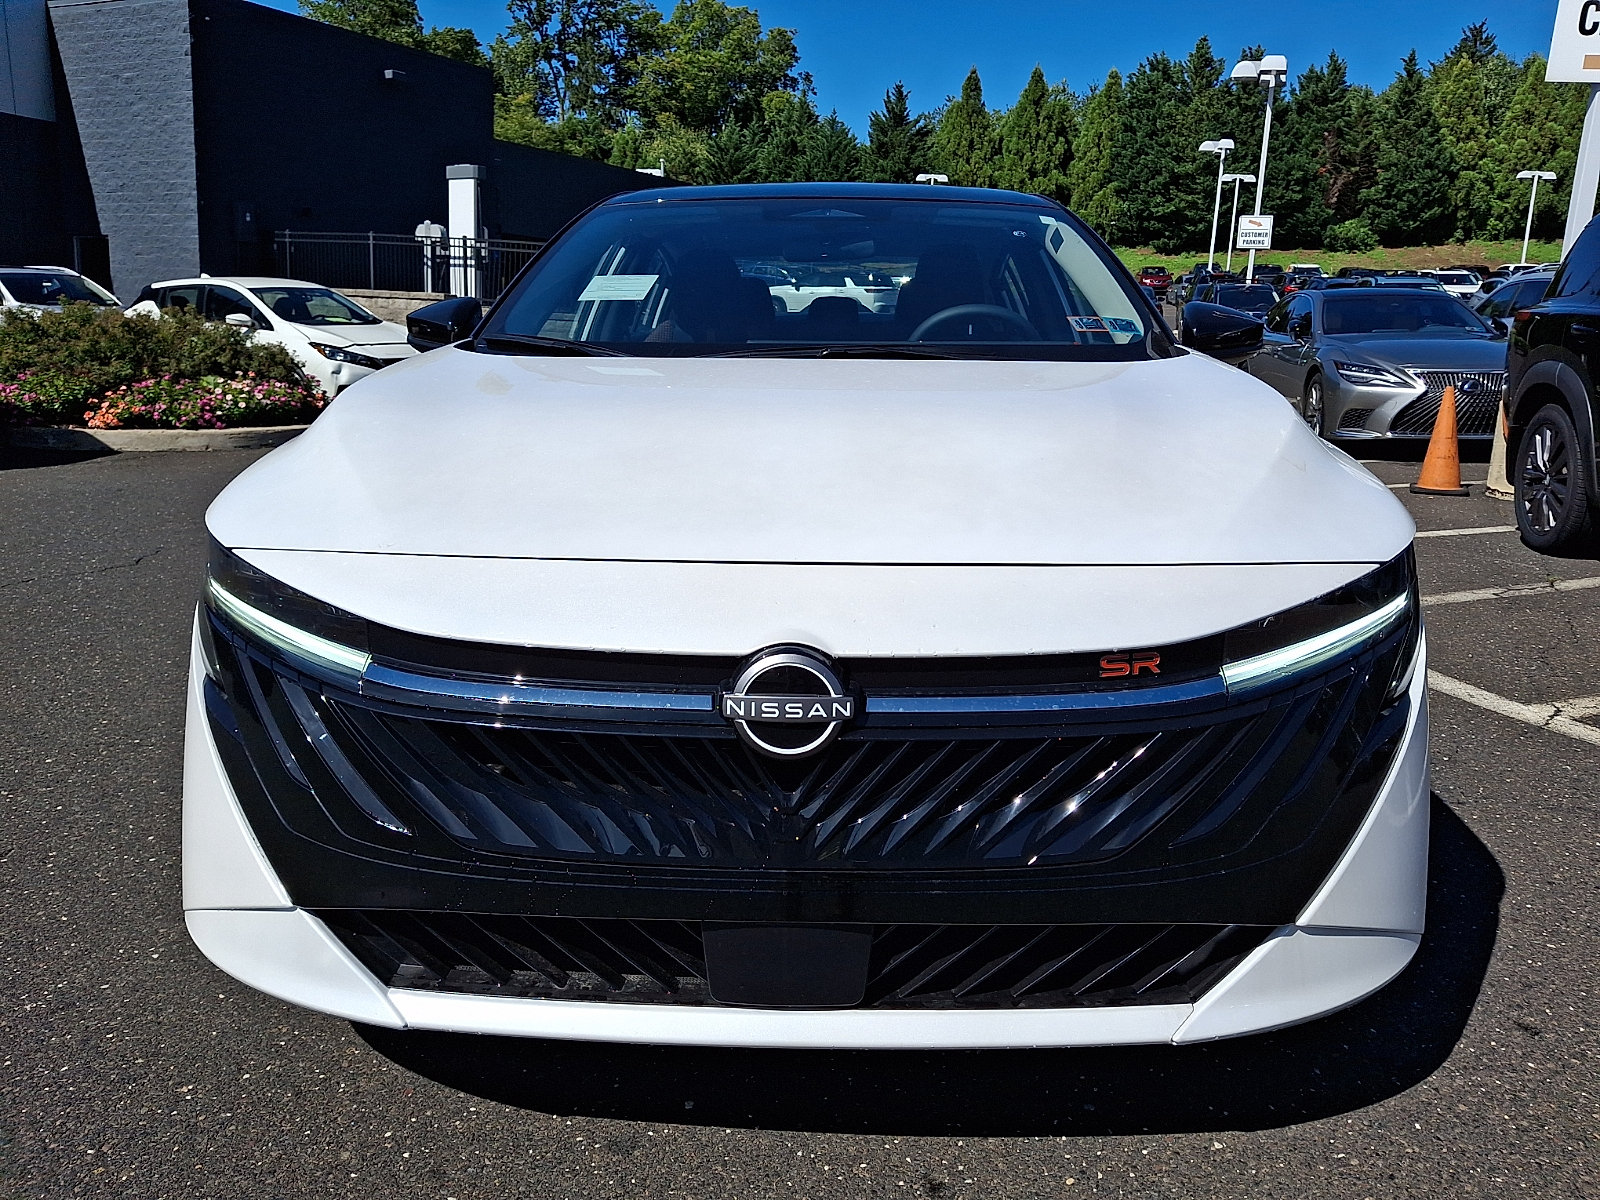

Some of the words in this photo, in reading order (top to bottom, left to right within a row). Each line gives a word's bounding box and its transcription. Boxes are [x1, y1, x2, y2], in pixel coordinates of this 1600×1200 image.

[1579, 0, 1600, 36] C
[1100, 652, 1160, 677] SR
[726, 699, 850, 718] NISSAN
